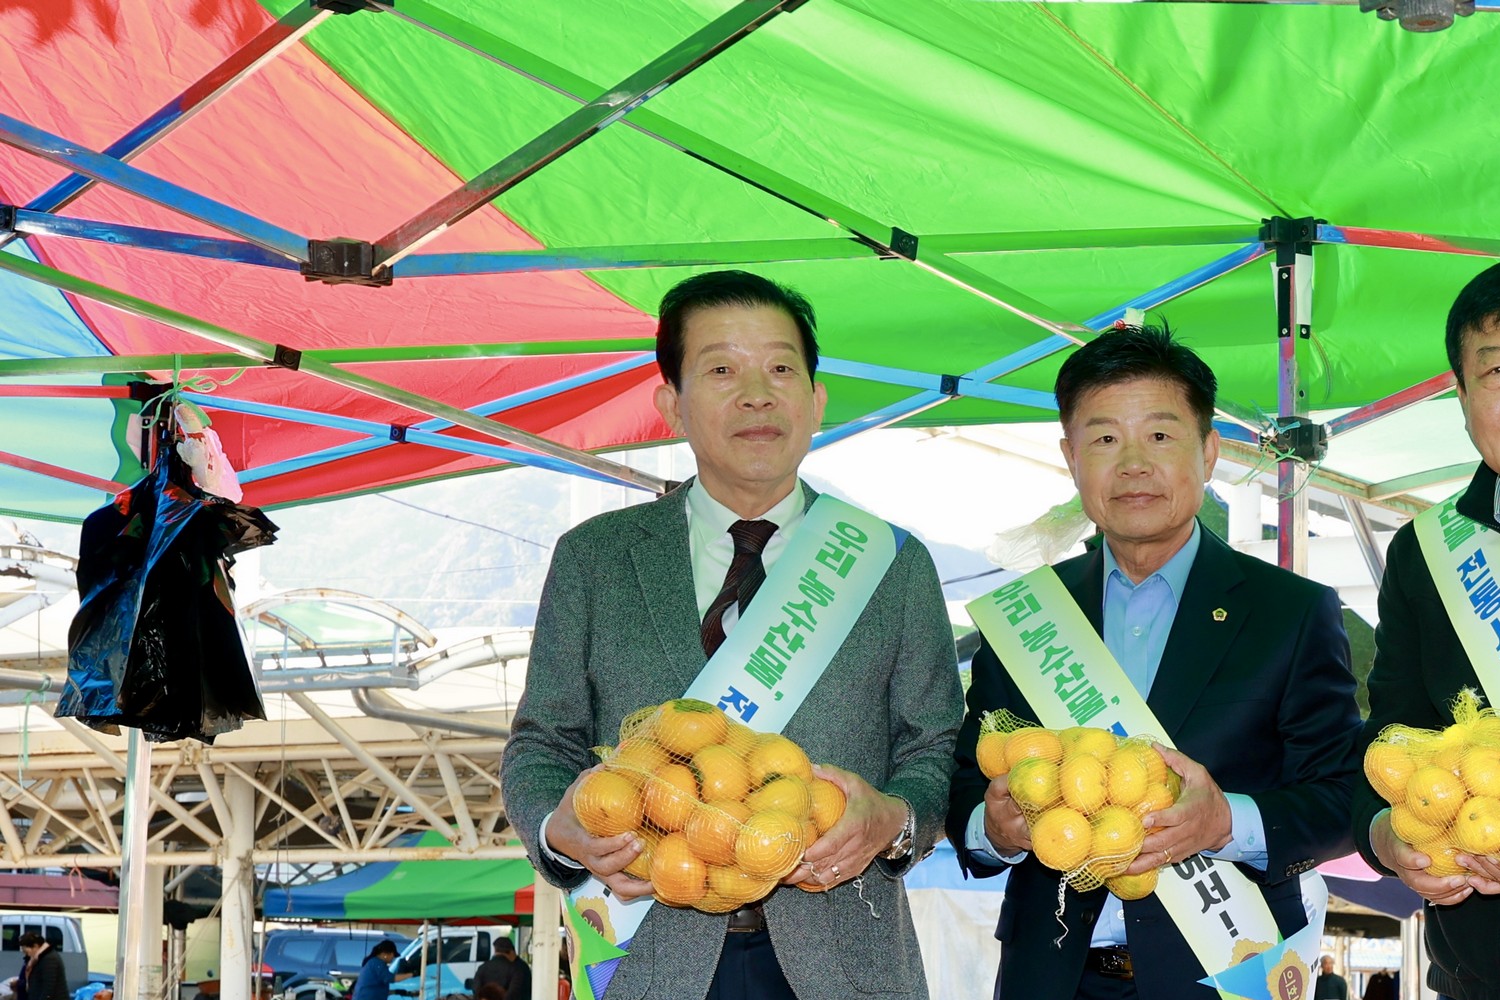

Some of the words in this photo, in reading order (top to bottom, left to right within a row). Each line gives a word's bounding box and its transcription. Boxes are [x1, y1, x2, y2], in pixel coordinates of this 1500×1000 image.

[815, 521, 868, 579] 우리
[744, 568, 835, 701] 농수산물,
[992, 580, 1042, 627] 우리
[1019, 620, 1120, 726] 농수산물,
